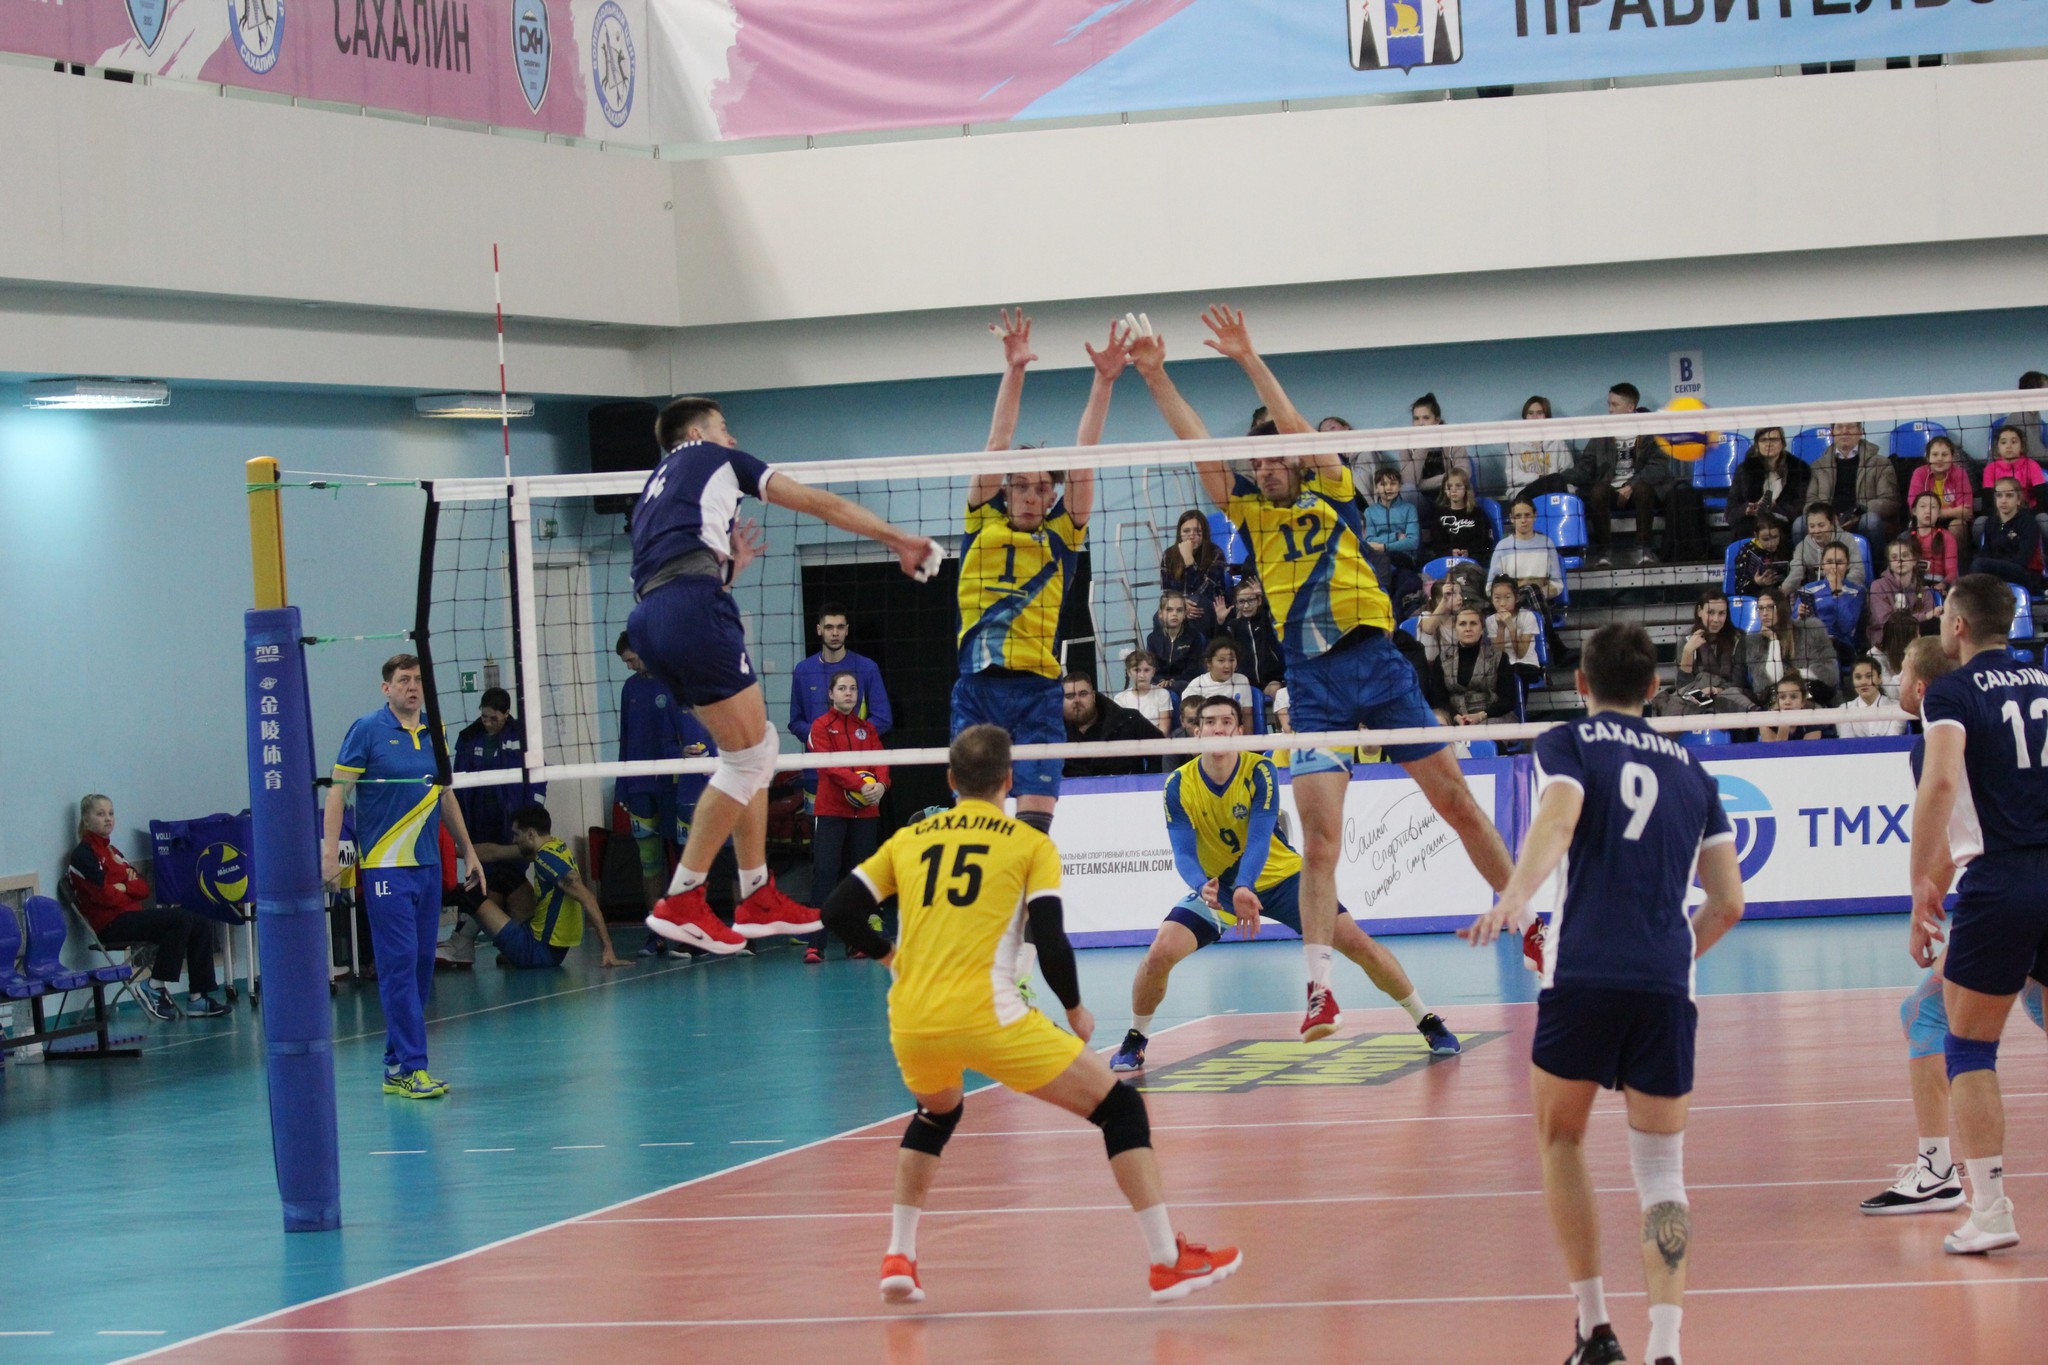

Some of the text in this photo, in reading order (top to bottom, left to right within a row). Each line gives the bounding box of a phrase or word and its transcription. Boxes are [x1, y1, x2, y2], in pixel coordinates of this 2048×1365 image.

[333, 0, 472, 74] САХАЛИН
[240, 43, 276, 71] САХАЛИН
[1674, 384, 1701, 393] СЕКТОР
[644, 464, 668, 503] 4
[1280, 513, 1326, 562] 12
[998, 544, 1016, 583] 1
[255, 645, 279, 655] FIVB
[740, 652, 750, 675] 4
[260, 695, 283, 790] 金陵体育
[1578, 721, 1689, 766] САХАЛИН
[2001, 697, 2048, 769] 12
[1620, 761, 1659, 841] 9
[915, 814, 1016, 836] САХАЛИН
[1219, 828, 1241, 854] 9
[1088, 850, 1124, 859] СПОРТИВНЫЙ
[1125, 849, 1140, 857] КЛУБ
[920, 843, 990, 907] 15
